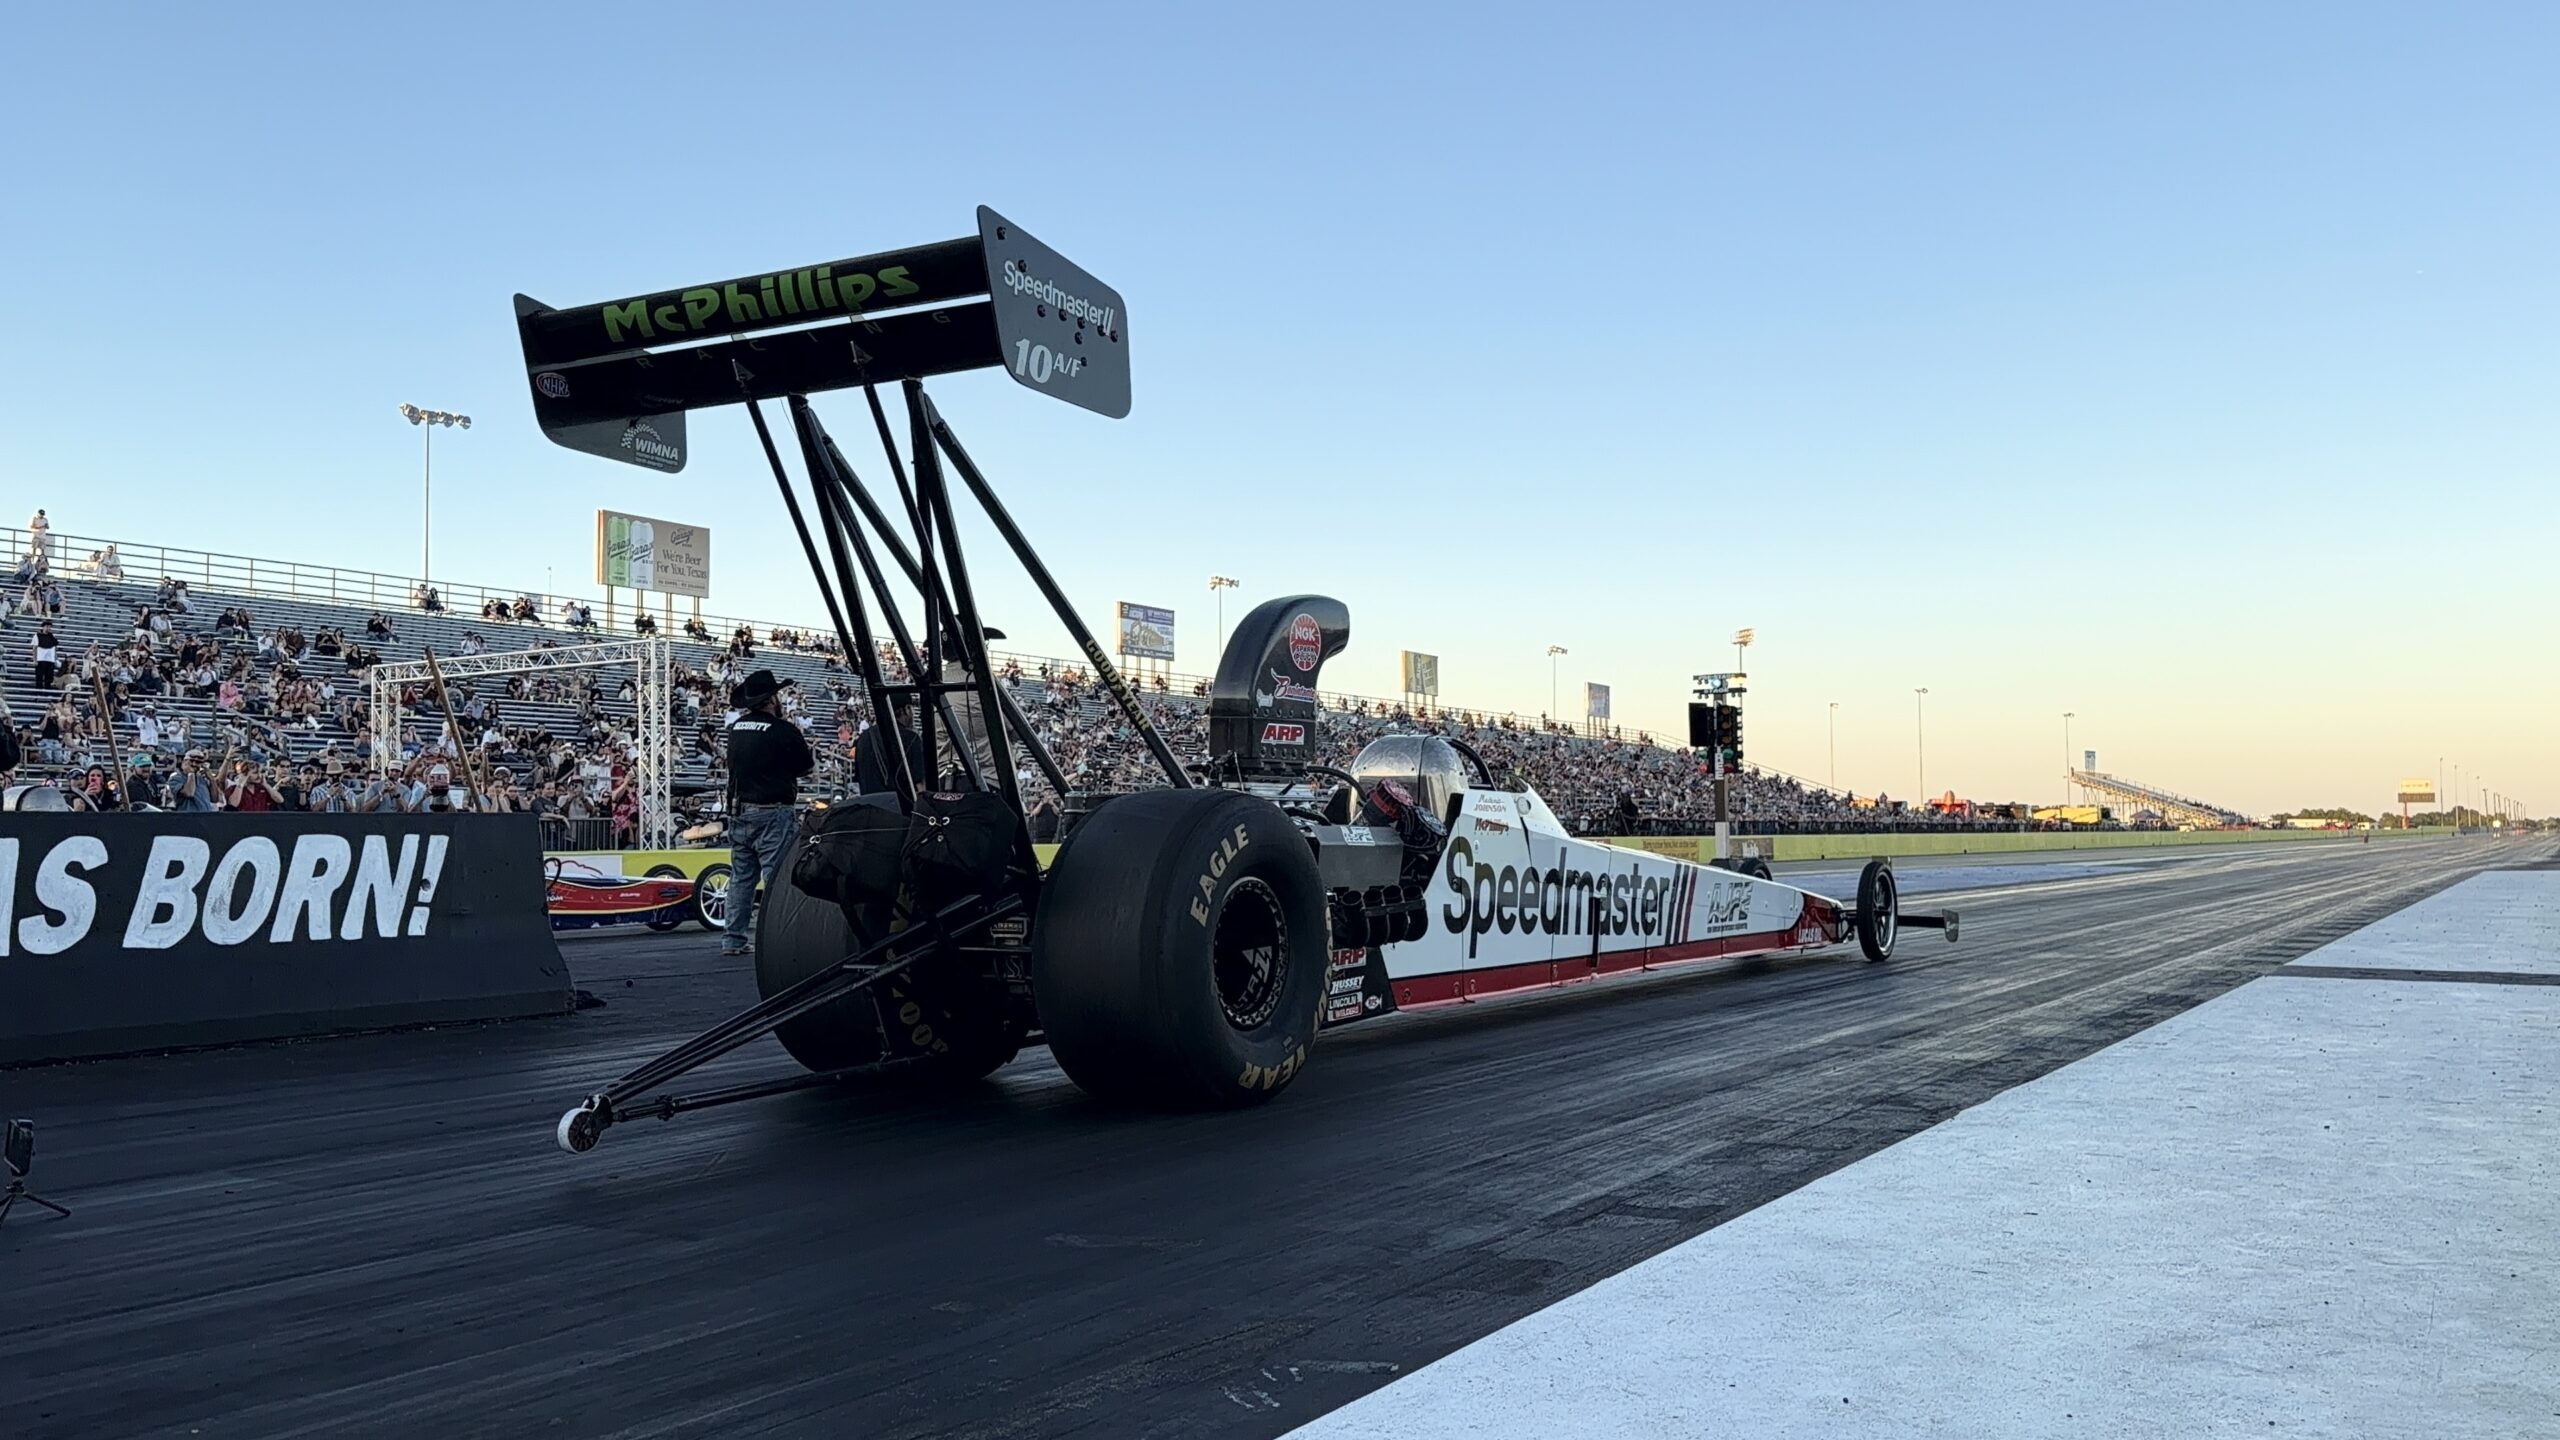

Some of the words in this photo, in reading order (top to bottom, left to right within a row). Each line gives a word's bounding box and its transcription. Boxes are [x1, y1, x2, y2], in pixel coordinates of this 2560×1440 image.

[603, 266, 920, 342] McPhillips
[1015, 338, 1052, 383] 10
[1053, 352, 1082, 377] A/F
[634, 438, 679, 460] WIMNA
[656, 561, 670, 573] For
[686, 566, 707, 579] Texas
[1295, 627, 1316, 642] NGK
[732, 721, 773, 732] SECURITY
[1263, 725, 1304, 742] ARP
[1190, 823, 1250, 928] EAGLE
[122, 834, 450, 950] BORN!
[1330, 975, 1365, 995] HUSSEY
[1329, 996, 1357, 1009] LINCOLN
